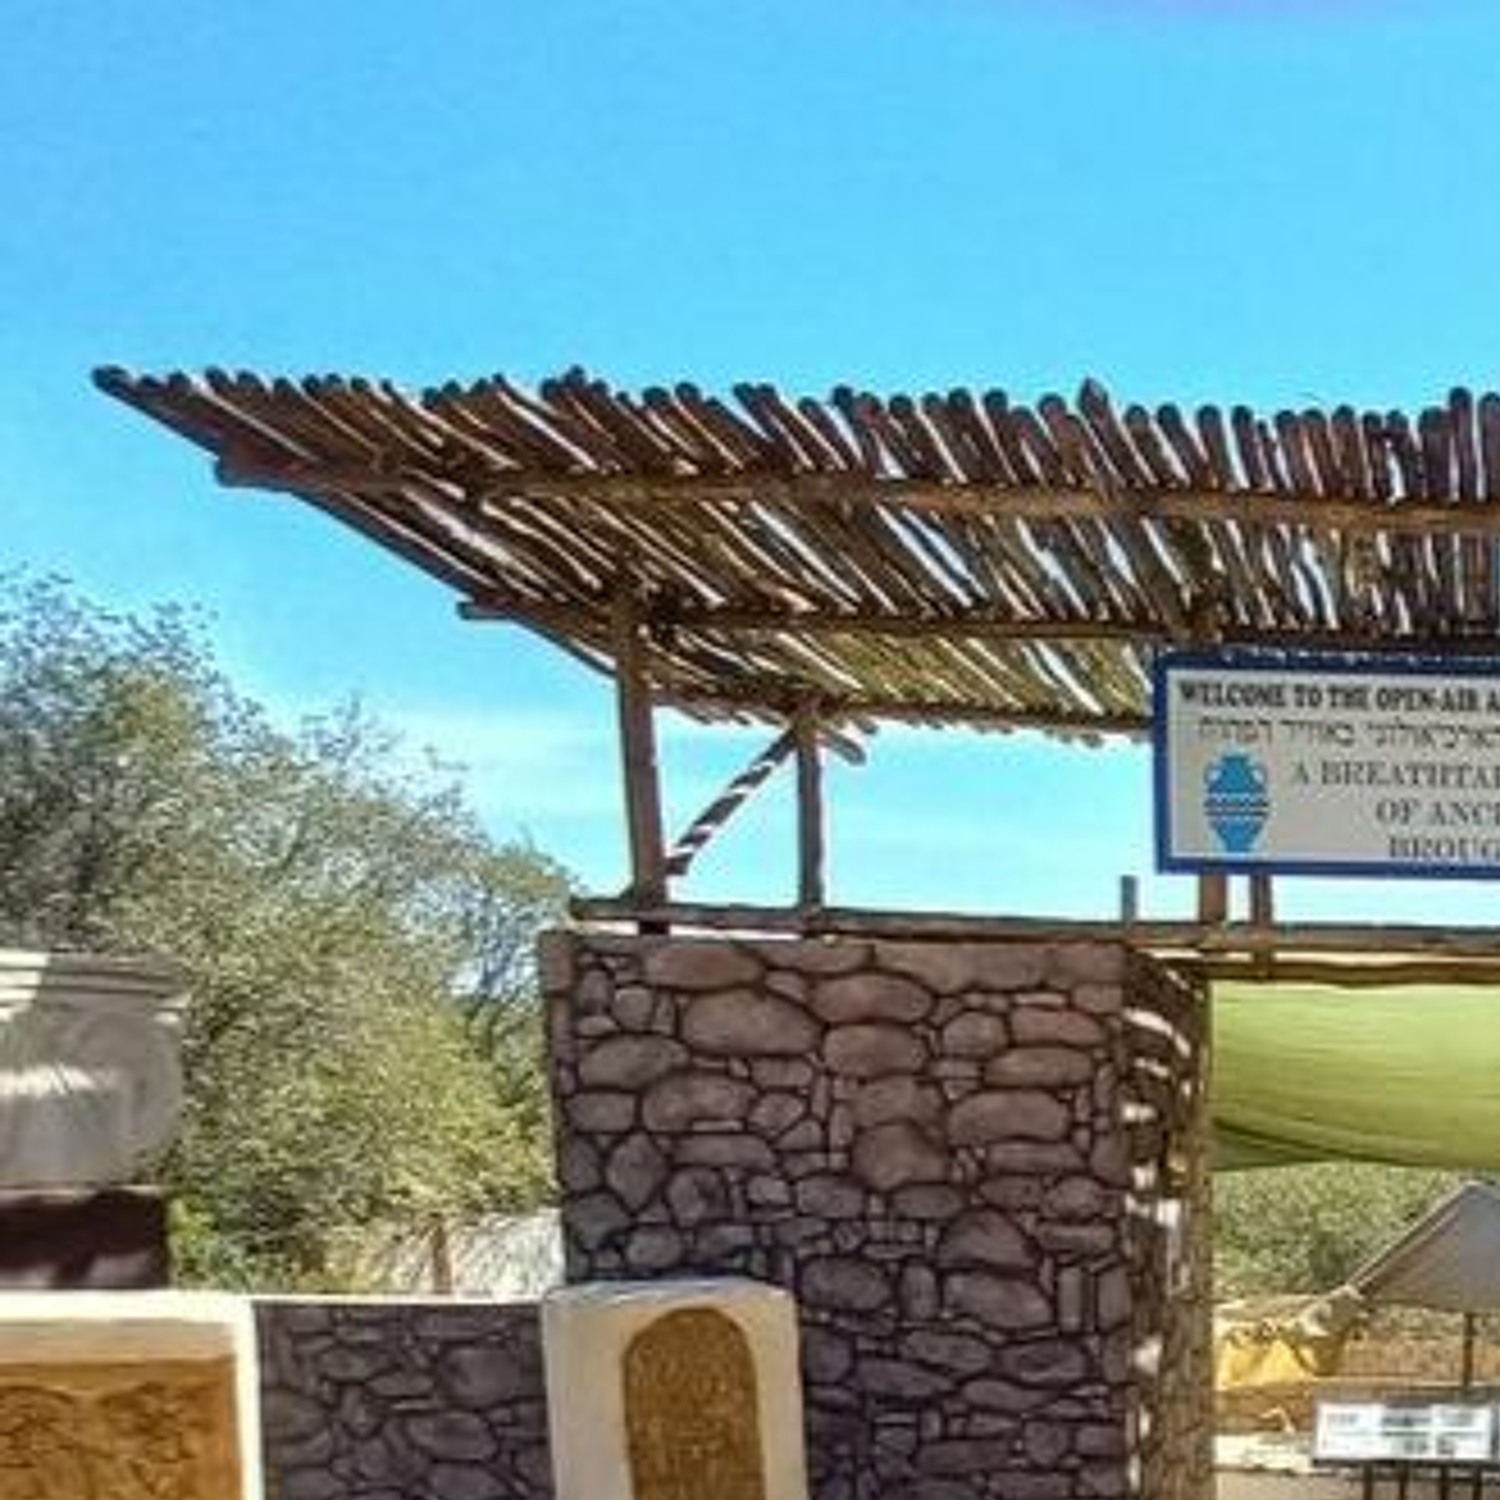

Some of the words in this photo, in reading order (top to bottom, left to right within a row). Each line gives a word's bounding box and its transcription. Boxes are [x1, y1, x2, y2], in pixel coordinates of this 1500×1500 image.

[1179, 681, 1285, 706] WELCOME
[1294, 684, 1322, 707] TO
[1327, 685, 1370, 709] THE
[1293, 761, 1310, 786] A
[1375, 798, 1419, 825] OF
